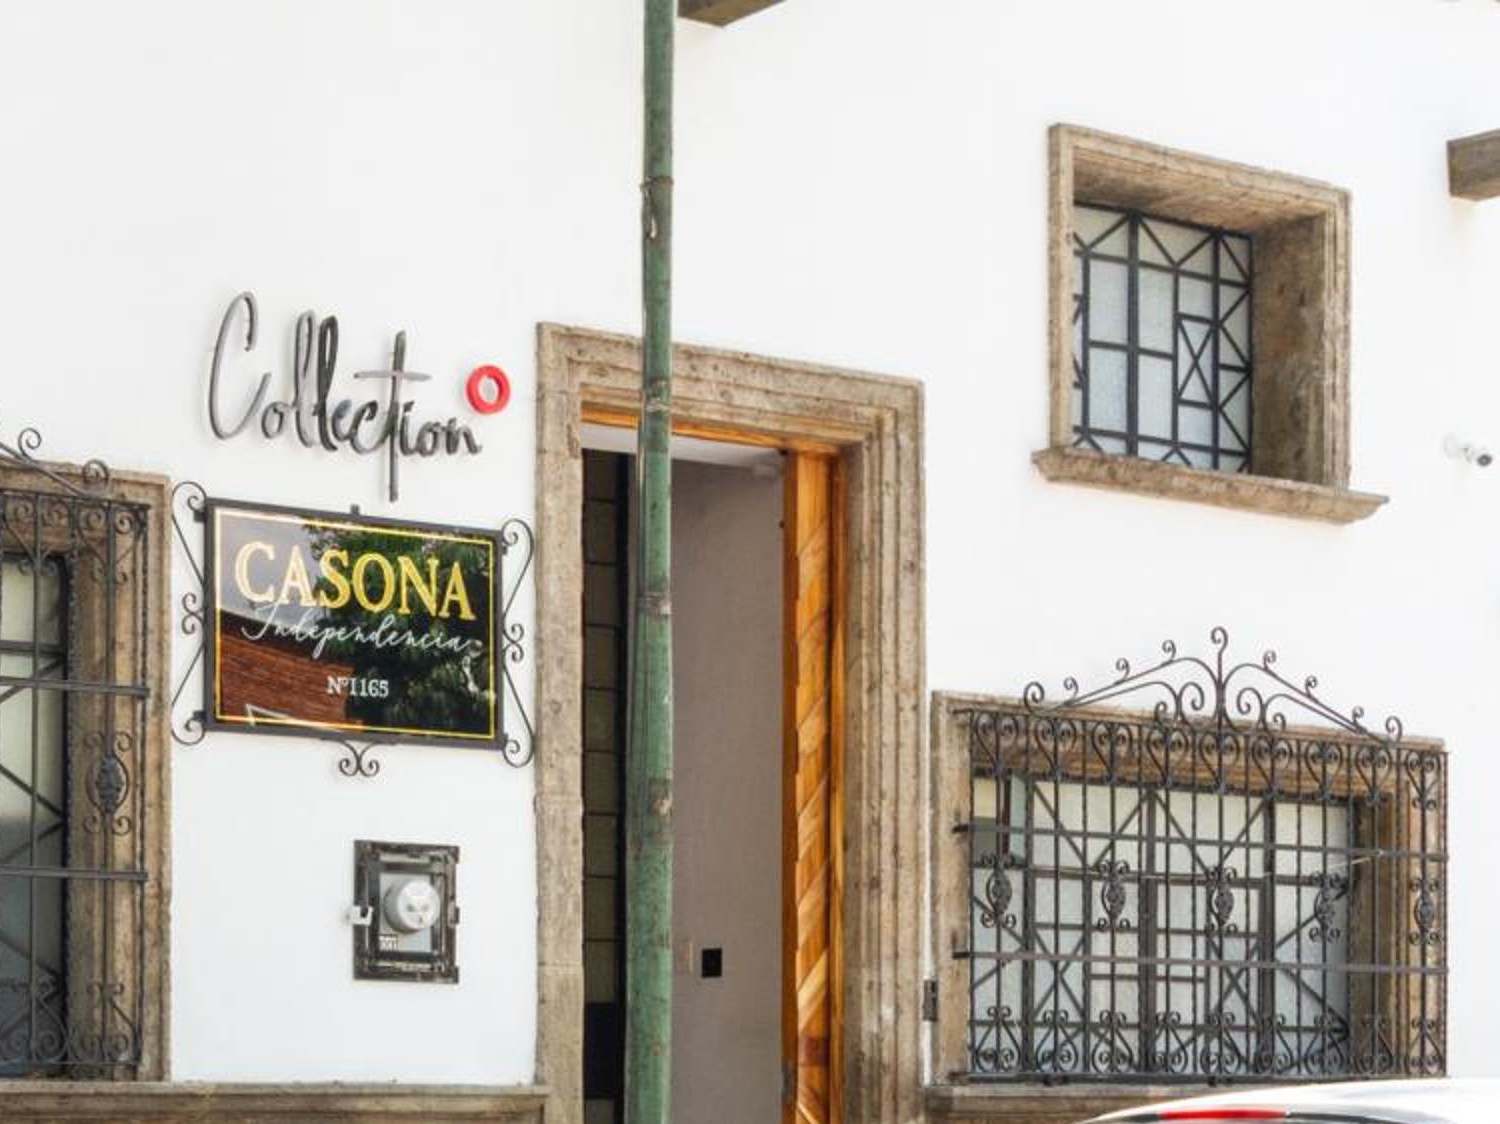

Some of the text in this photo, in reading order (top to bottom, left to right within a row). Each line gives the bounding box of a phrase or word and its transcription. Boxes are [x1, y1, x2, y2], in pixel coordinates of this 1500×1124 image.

[209, 290, 482, 502] Collection
[235, 541, 476, 621] CASONA
[241, 597, 478, 660] Independencia
